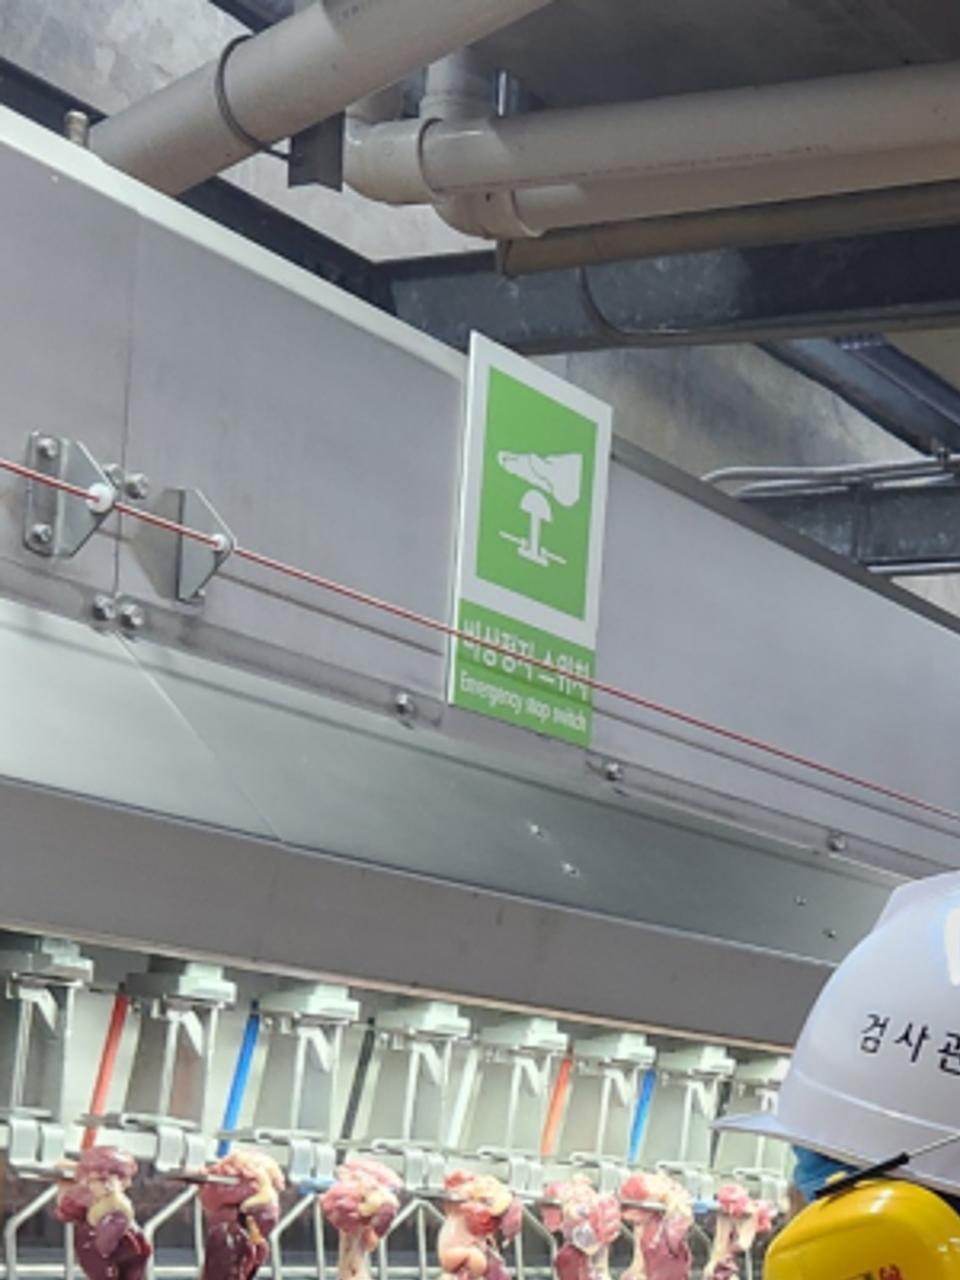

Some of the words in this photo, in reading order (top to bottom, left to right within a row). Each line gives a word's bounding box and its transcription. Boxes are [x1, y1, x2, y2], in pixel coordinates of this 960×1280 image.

[460, 670, 523, 715] Emergency
[525, 696, 551, 724] stop
[552, 703, 587, 733] switch
